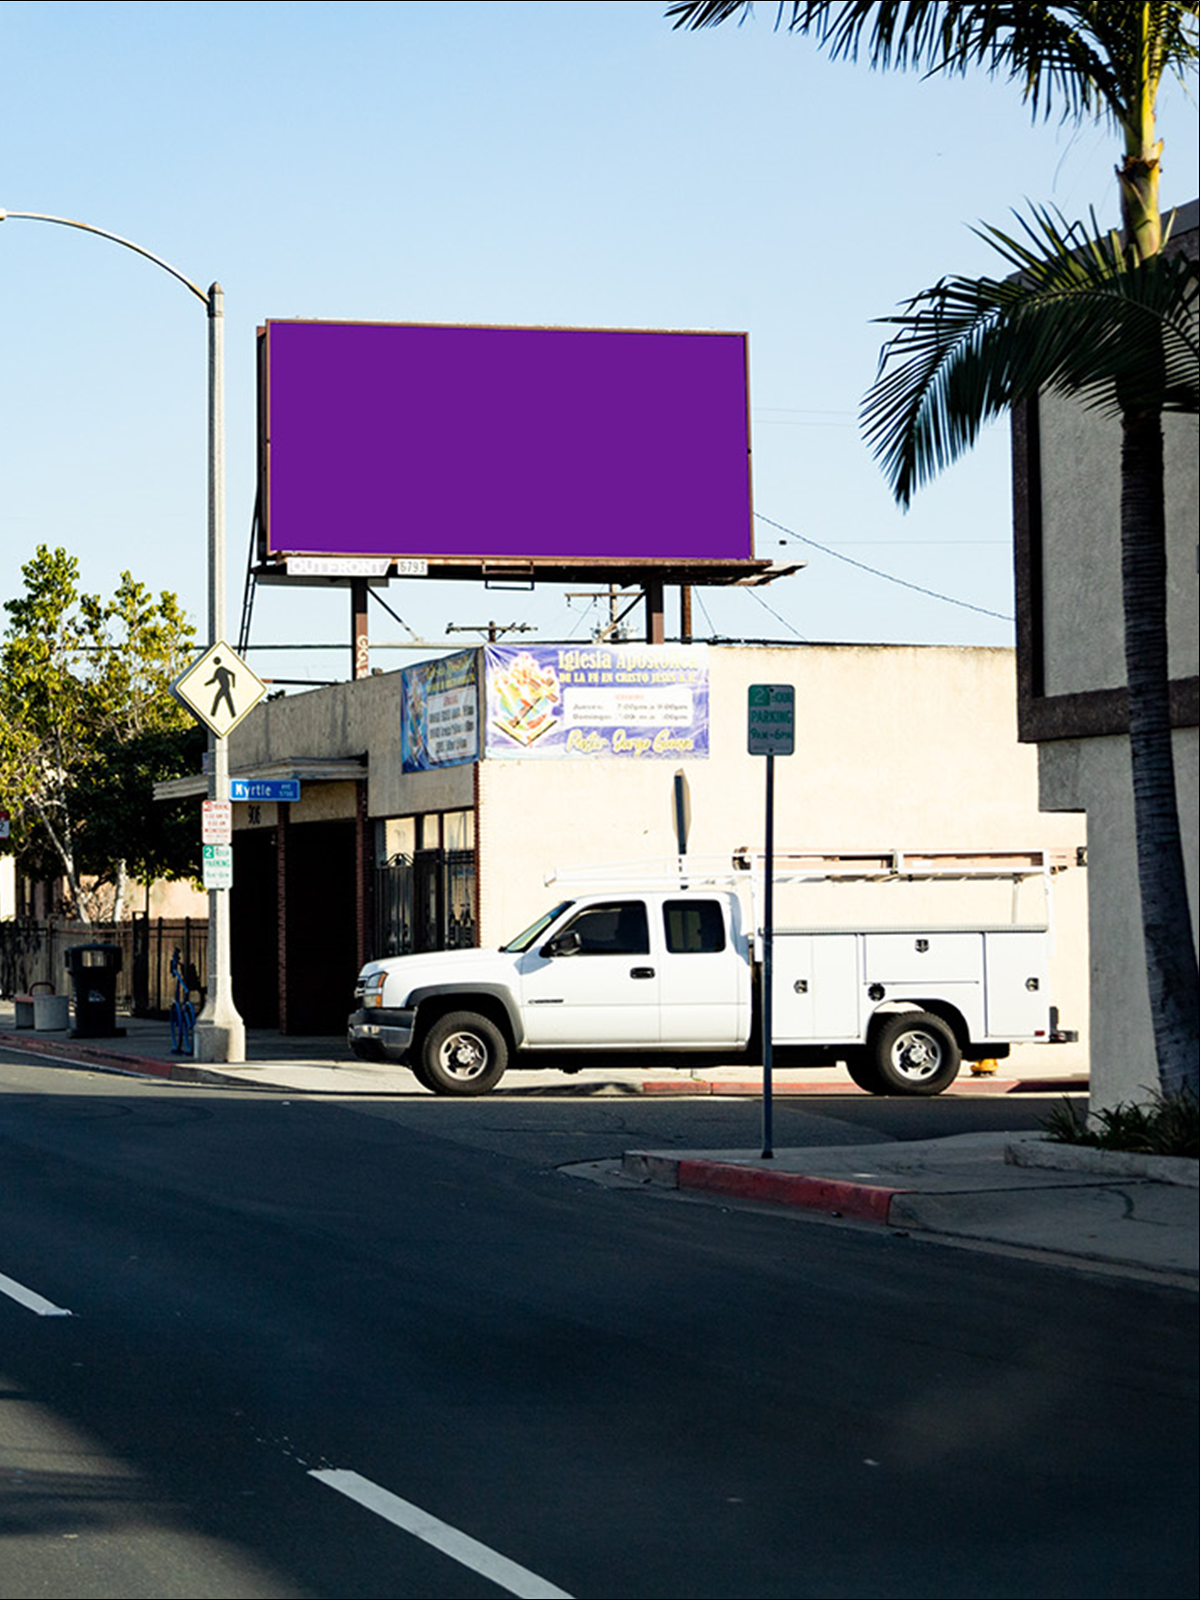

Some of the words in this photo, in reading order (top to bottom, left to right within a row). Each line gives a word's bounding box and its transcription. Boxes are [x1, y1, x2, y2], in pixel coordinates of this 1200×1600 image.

[291, 559, 385, 574] OUTFRONT
[557, 650, 611, 671] Iglesia
[574, 673, 585, 683] LA
[601, 673, 613, 683] EN
[615, 673, 649, 683] CRISTO
[754, 688, 765, 703] 2
[751, 710, 792, 724] PARKING
[235, 783, 272, 798] Myrtle
[205, 846, 213, 858] 2
